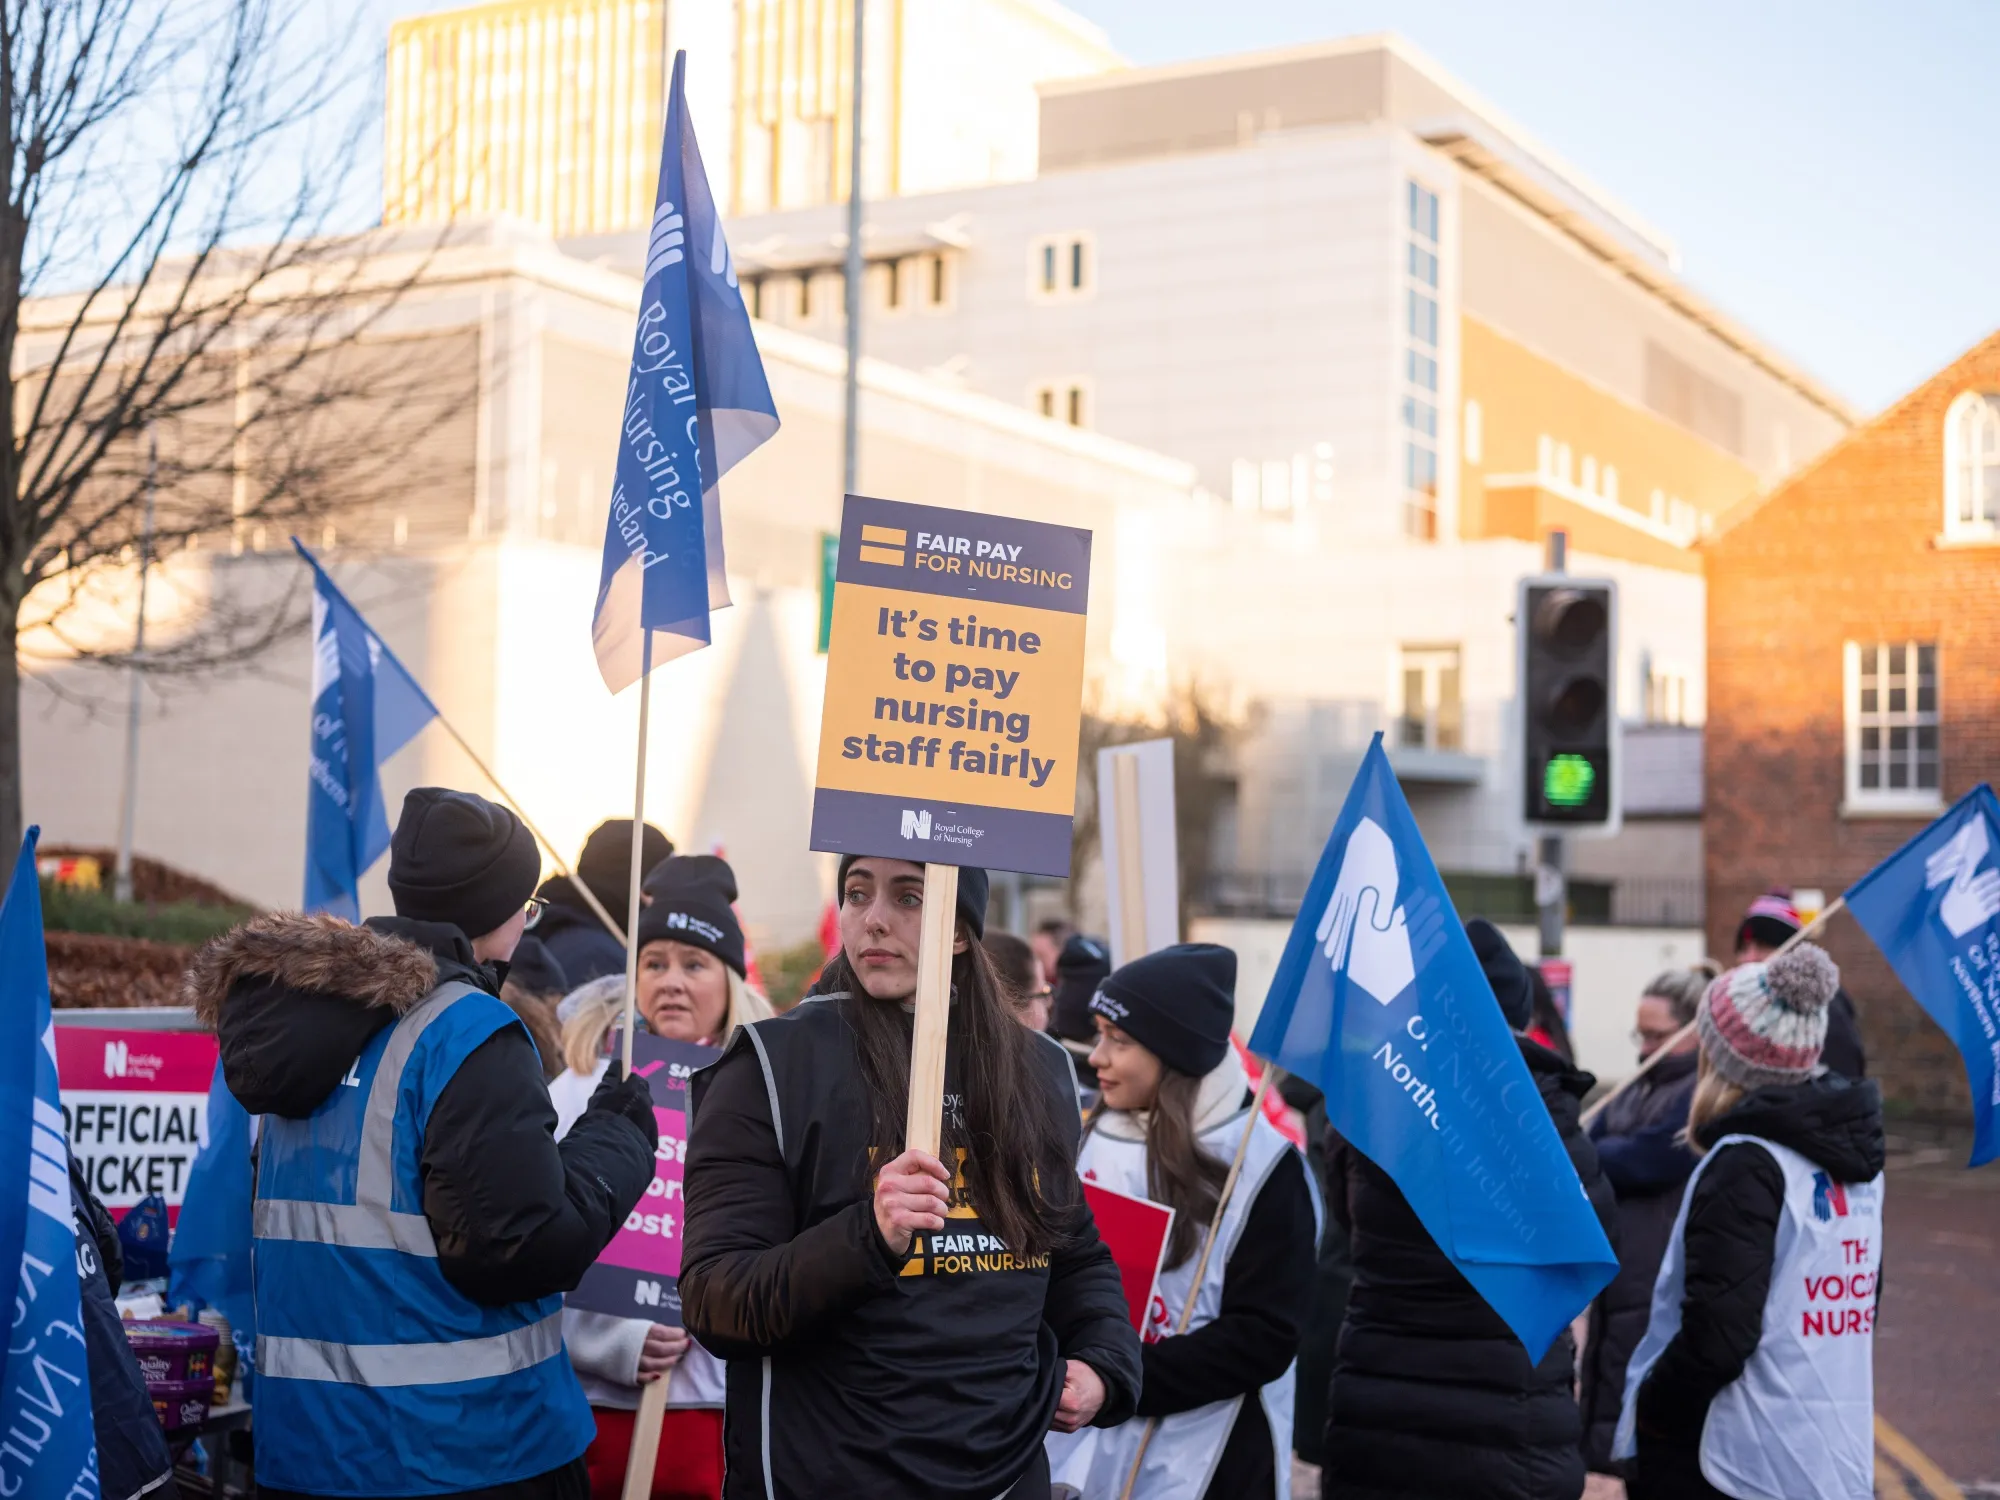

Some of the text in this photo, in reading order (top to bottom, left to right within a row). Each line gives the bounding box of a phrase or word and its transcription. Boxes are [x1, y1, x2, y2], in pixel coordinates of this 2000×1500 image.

[916, 532, 1023, 562] FAIR PAY
[915, 552, 1072, 590] FOR NURSING
[878, 607, 1041, 654] It's time
[894, 653, 1020, 700] to pay
[874, 696, 1031, 743] nursing
[842, 733, 1056, 787] staff fairly
[933, 833, 973, 847] of Nursing
[934, 822, 985, 838] Royal College
[623, 1210, 676, 1239] ost
[931, 1234, 1004, 1254] FAIR PA
[1842, 1238, 1869, 1264] TH
[933, 1255, 973, 1275] FOR
